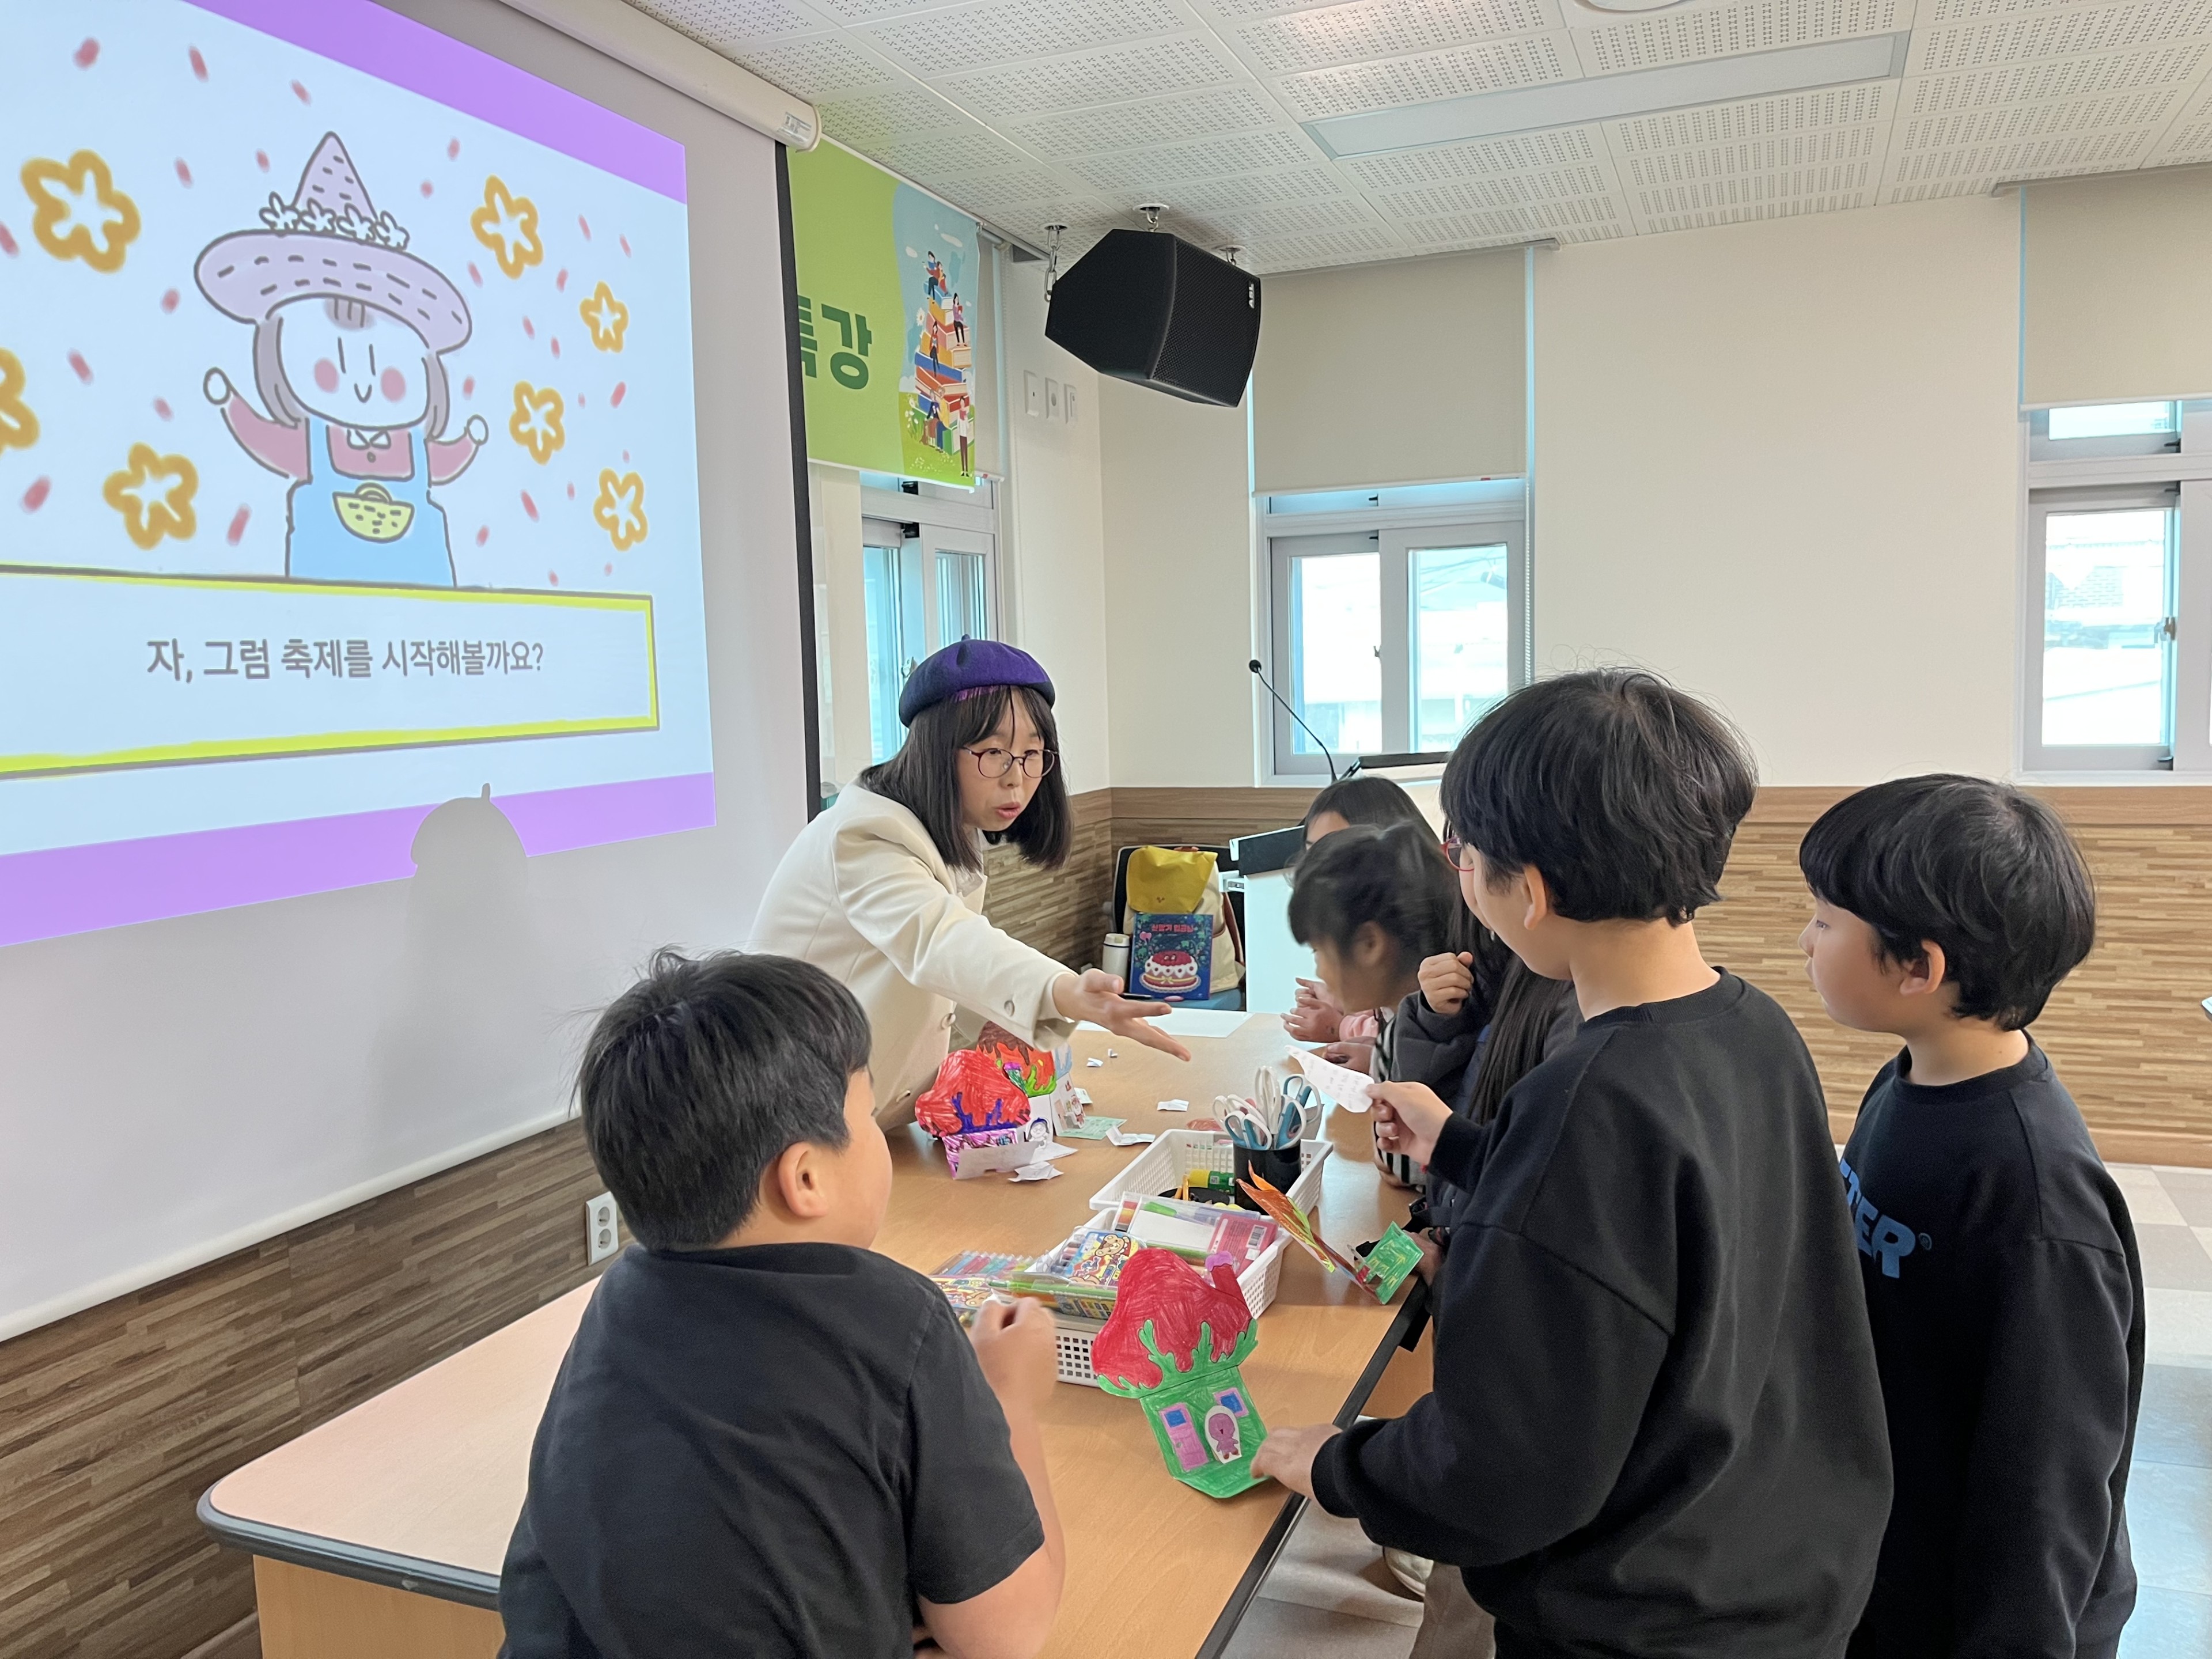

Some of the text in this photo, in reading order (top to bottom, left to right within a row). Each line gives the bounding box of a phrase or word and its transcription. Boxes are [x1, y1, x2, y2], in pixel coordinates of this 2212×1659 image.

[146, 638, 544, 684] 자, 그럼 축제를 시작해볼까요?
